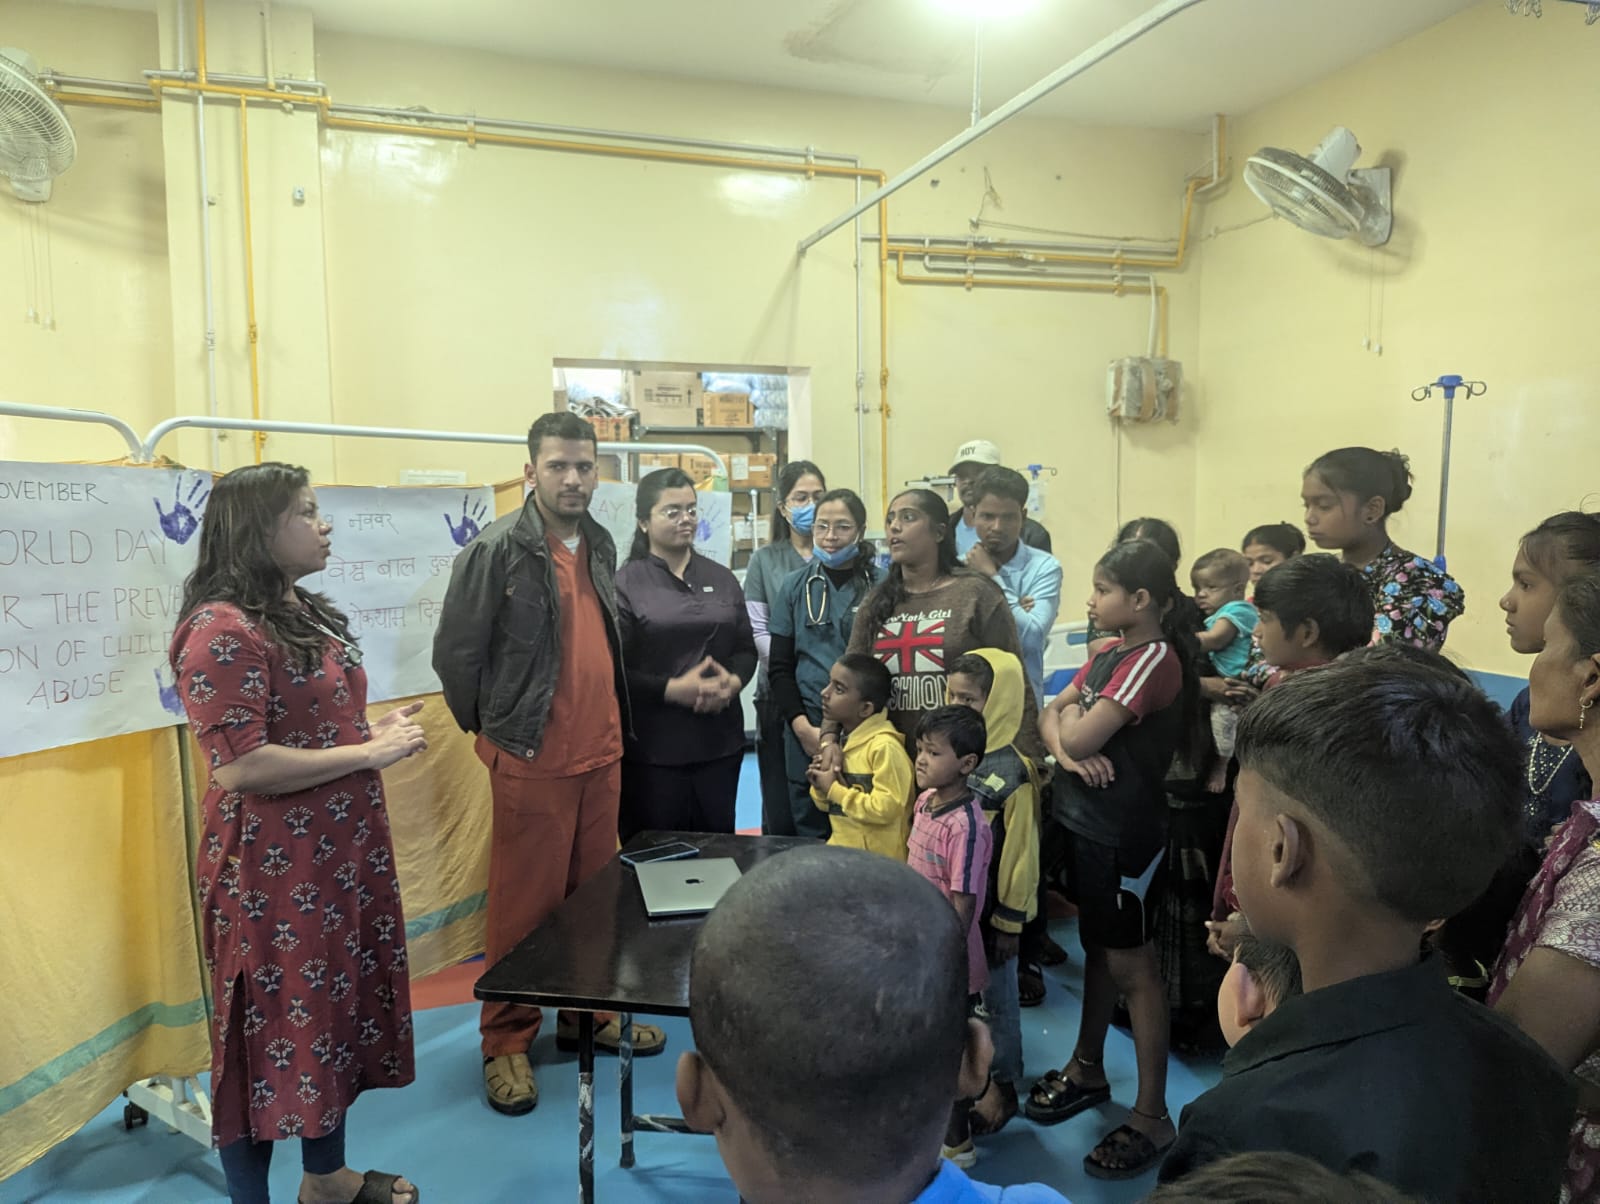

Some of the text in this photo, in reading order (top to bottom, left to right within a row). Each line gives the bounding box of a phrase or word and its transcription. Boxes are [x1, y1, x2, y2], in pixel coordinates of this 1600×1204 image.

[115, 529, 168, 564] DAY
[41, 591, 100, 624] THE
[56, 640, 87, 667] OF
[26, 670, 124, 709] ABUSE
